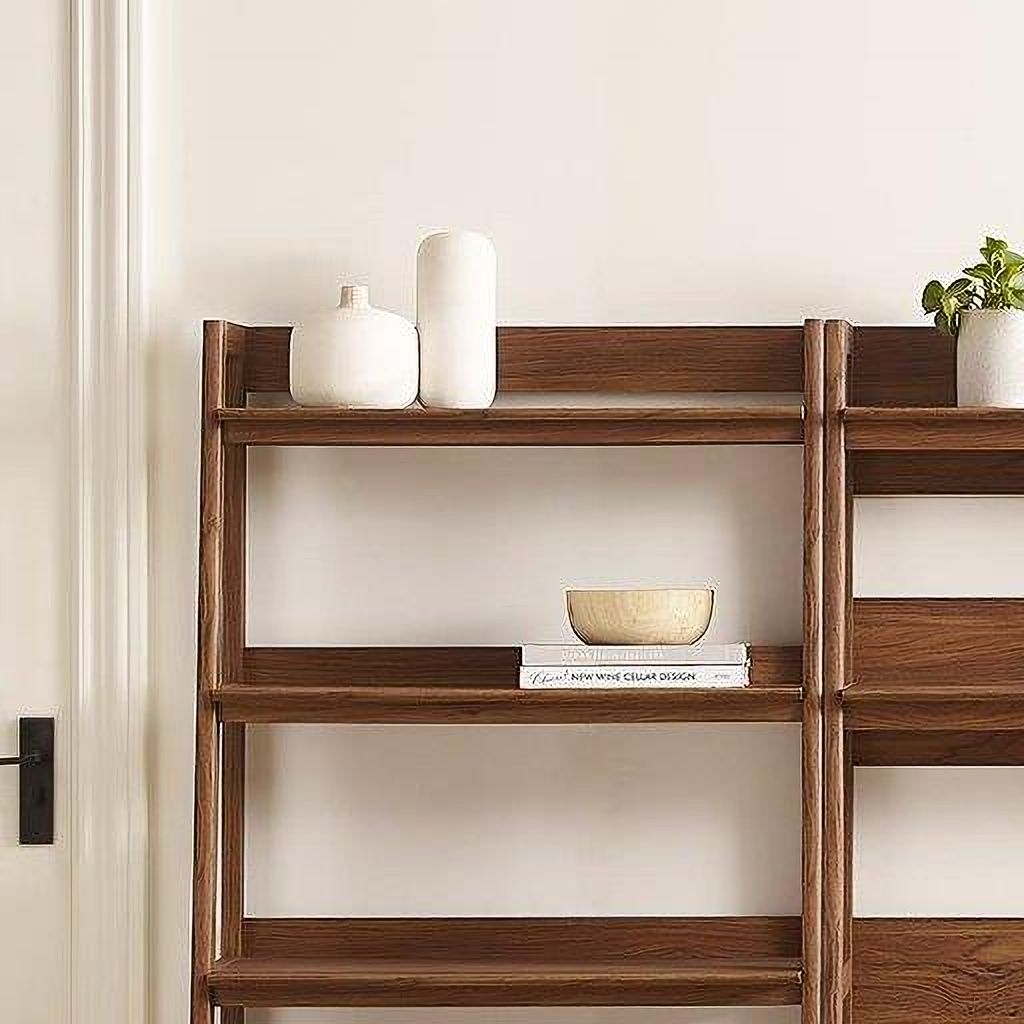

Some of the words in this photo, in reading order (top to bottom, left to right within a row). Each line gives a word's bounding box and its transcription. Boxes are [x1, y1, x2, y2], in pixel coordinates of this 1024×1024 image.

[571, 672, 594, 681] NEW
[623, 672, 657, 681] CELLAR
[659, 672, 696, 681] DESIGN
